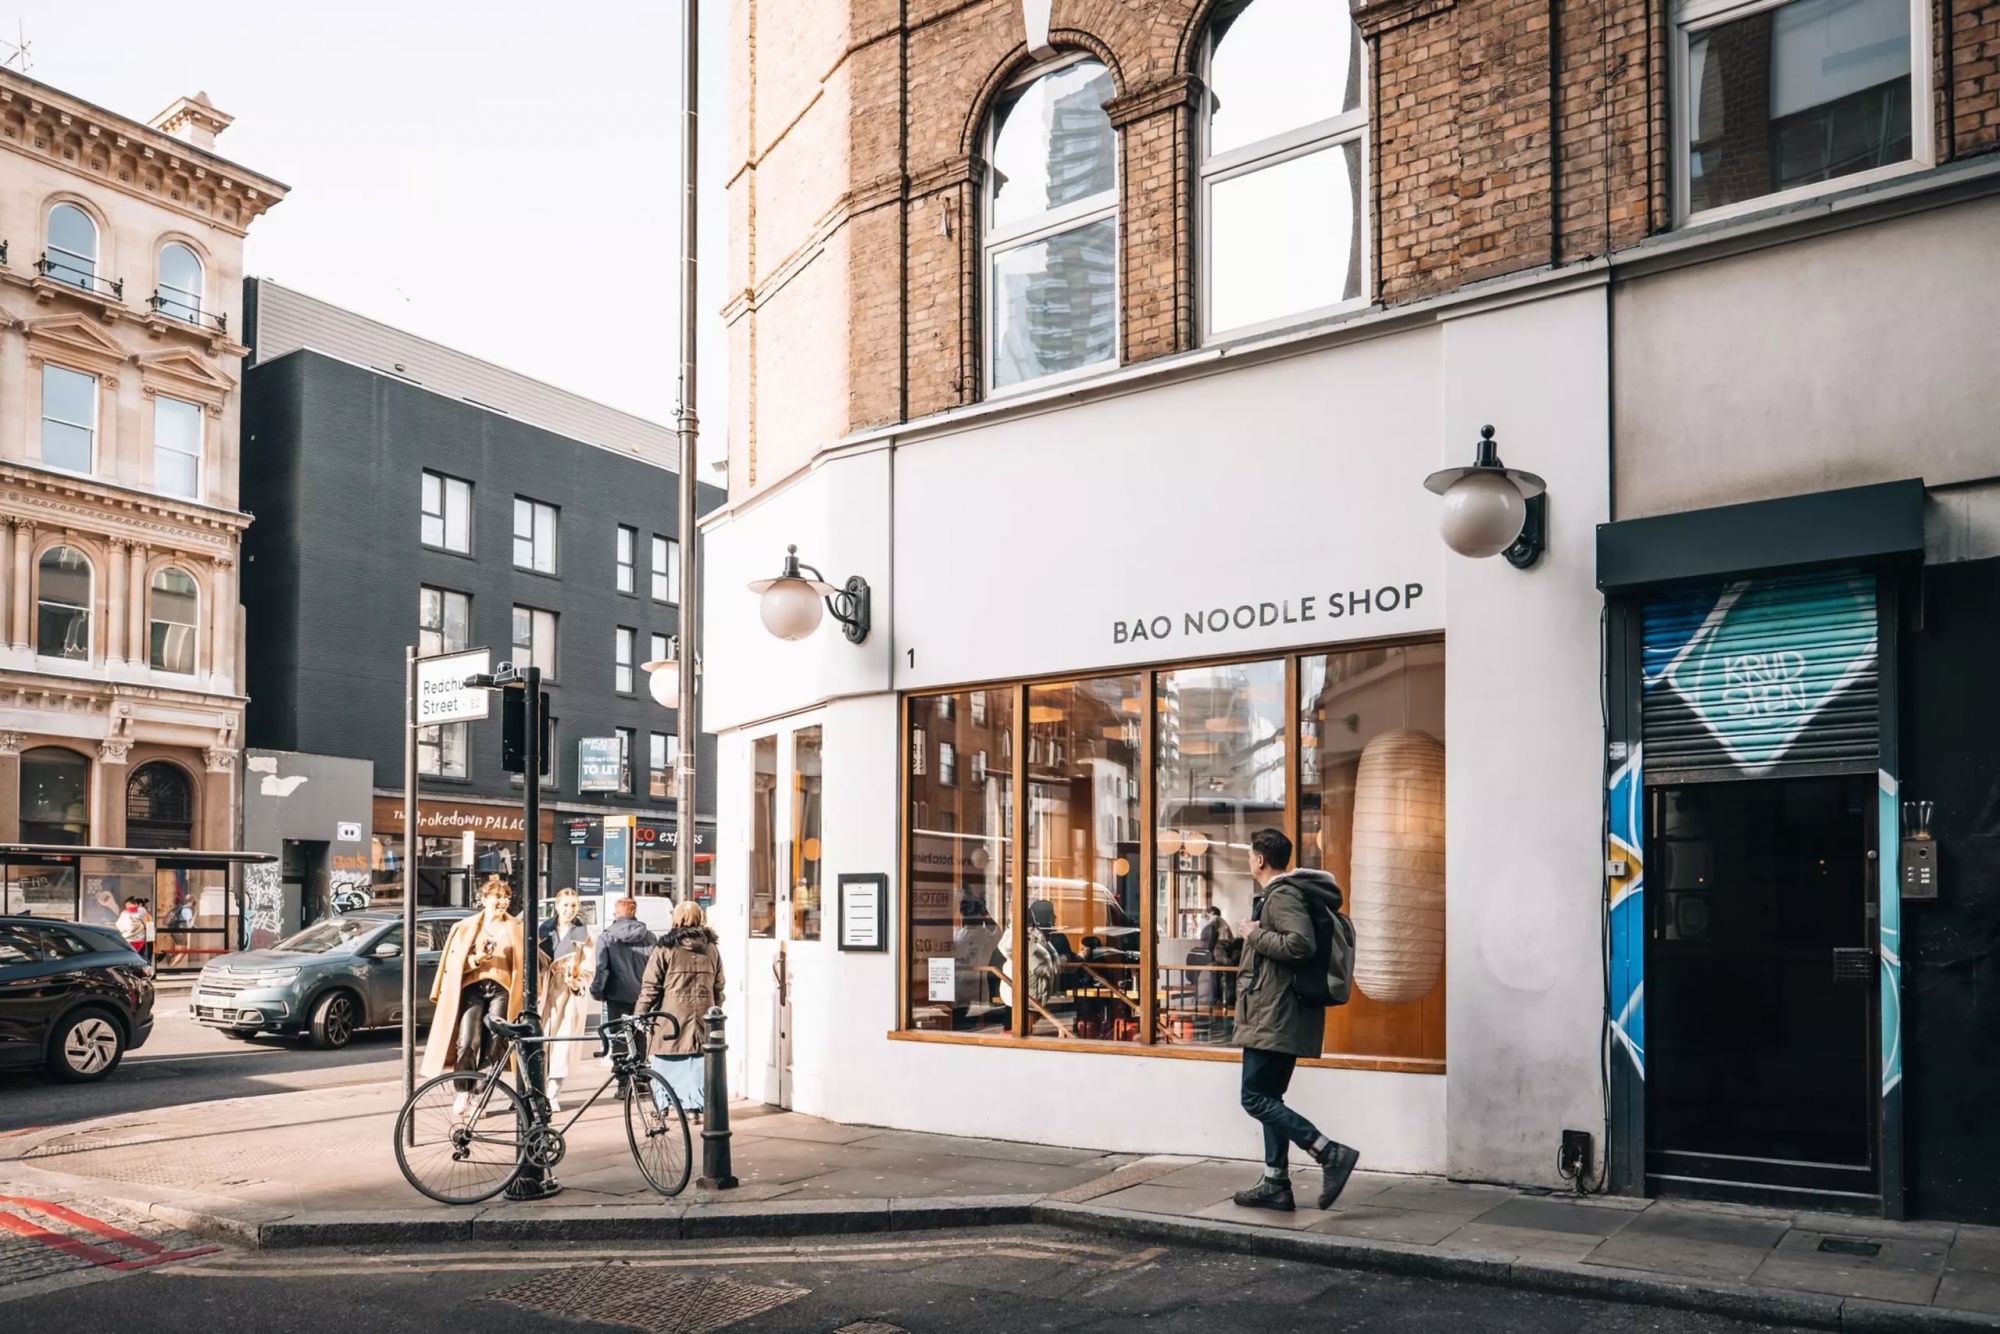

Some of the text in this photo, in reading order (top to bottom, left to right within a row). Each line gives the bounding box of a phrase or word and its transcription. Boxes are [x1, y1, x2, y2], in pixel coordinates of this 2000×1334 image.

[1113, 583, 1423, 644] BAO NOODLE SHOP
[907, 648, 914, 669] 1
[424, 677, 464, 695] Redchu
[423, 697, 458, 715] Street
[583, 764, 618, 775] TO LET
[394, 810, 406, 819] Th
[484, 816, 525, 831] PALAC
